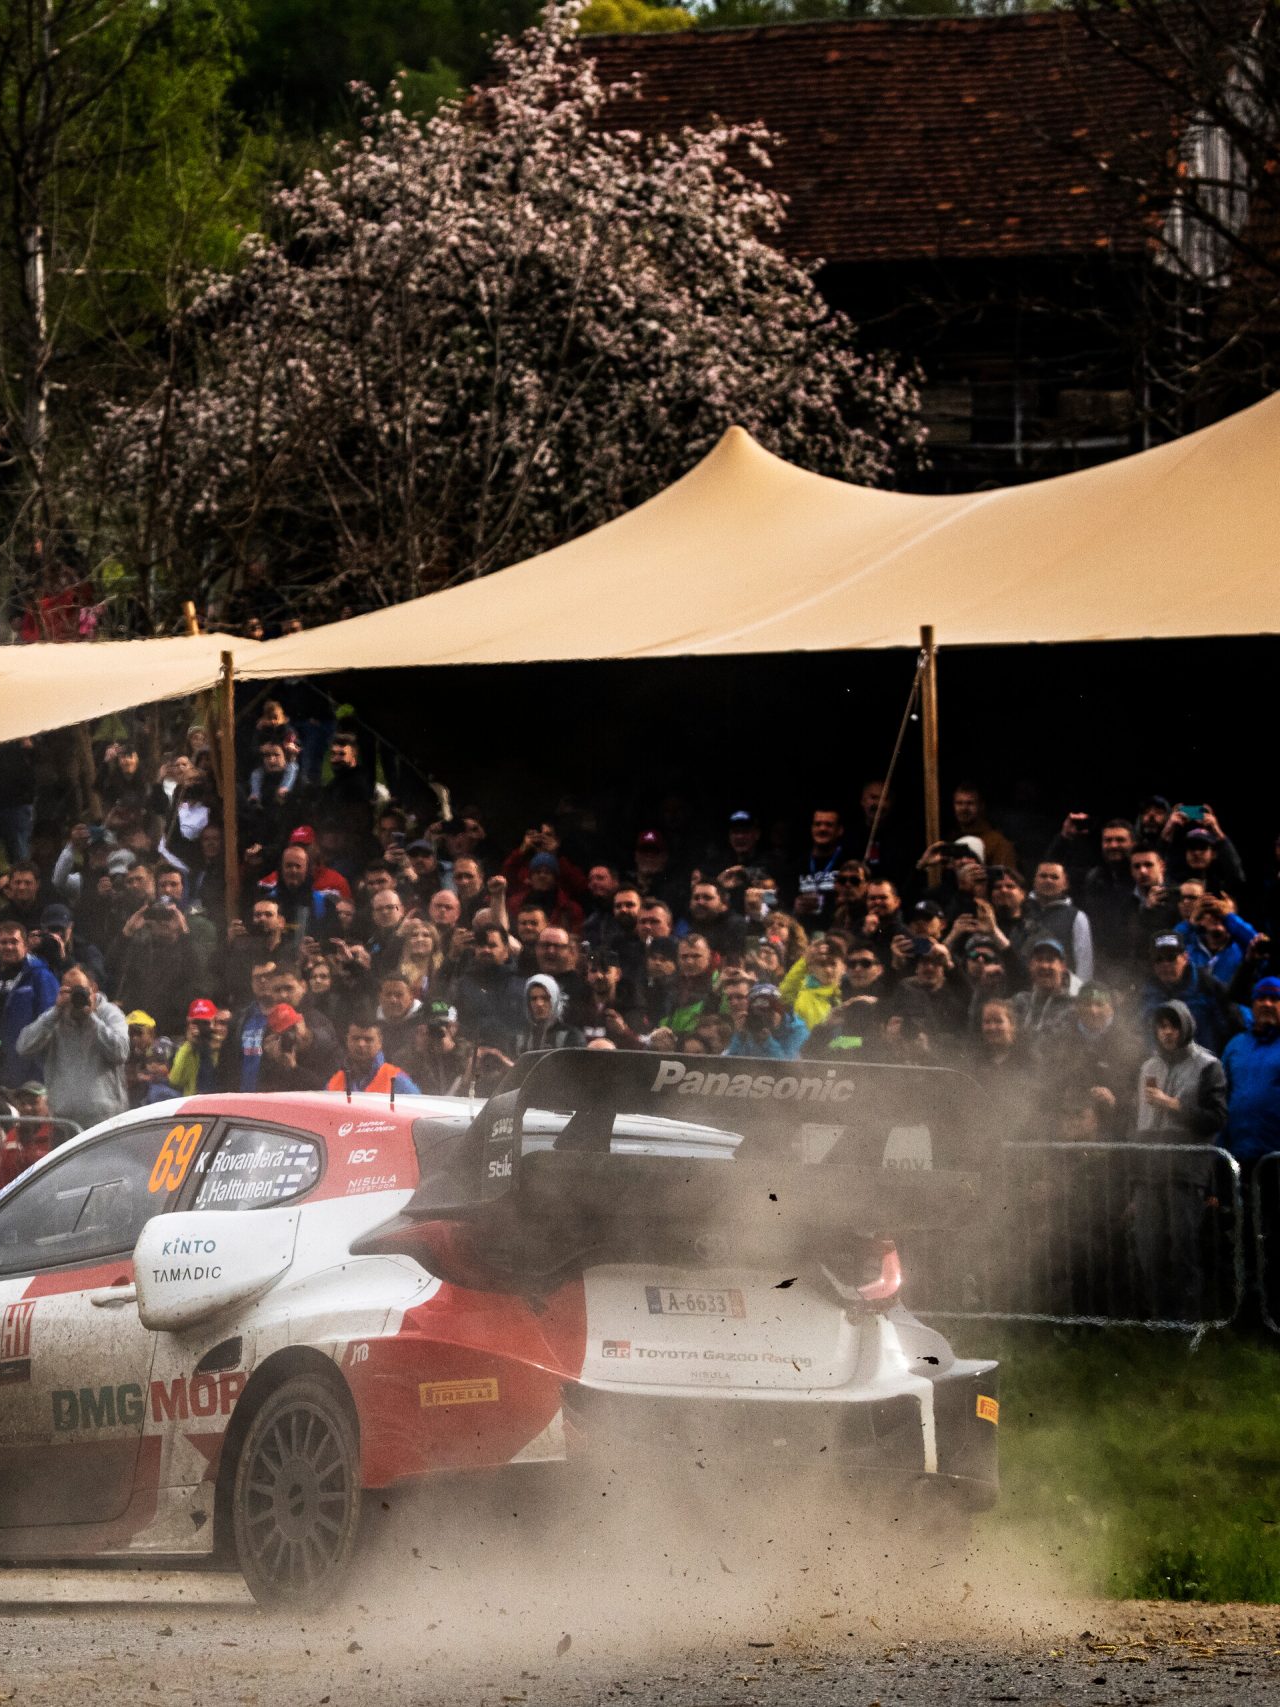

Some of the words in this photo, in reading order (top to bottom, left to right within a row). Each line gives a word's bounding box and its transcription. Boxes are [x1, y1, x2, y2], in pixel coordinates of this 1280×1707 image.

[650, 1060, 856, 1101] Panasonic
[147, 1123, 203, 1193] 69
[347, 1174, 397, 1189] NISULA
[152, 1266, 221, 1283] TAMADIC
[668, 1292, 726, 1313] A-6633
[635, 1348, 698, 1359] TOYOTA
[703, 1350, 758, 1362] GAZOO
[761, 1352, 812, 1368] Racing
[51, 1382, 144, 1431] DMG
